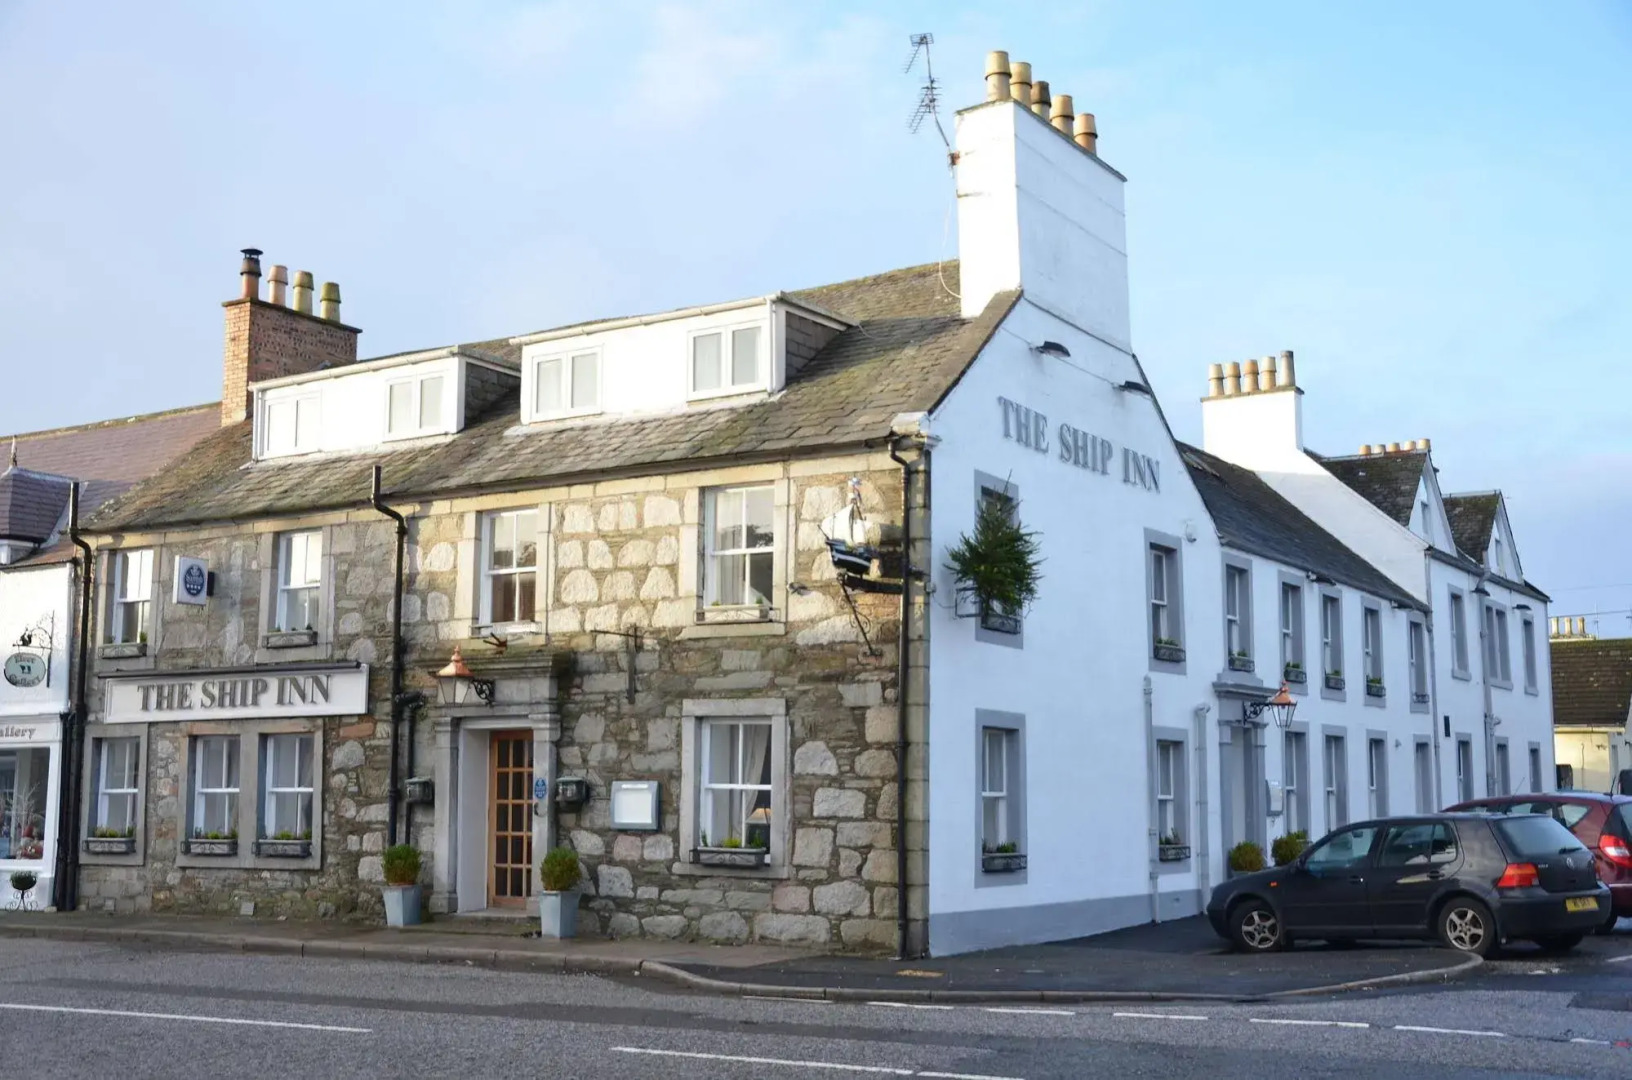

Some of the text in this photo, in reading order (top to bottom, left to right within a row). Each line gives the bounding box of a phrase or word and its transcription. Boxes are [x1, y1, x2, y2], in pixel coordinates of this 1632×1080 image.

[997, 396, 1160, 493] THE SHIP INN
[137, 674, 331, 711] THE SHIP INN
